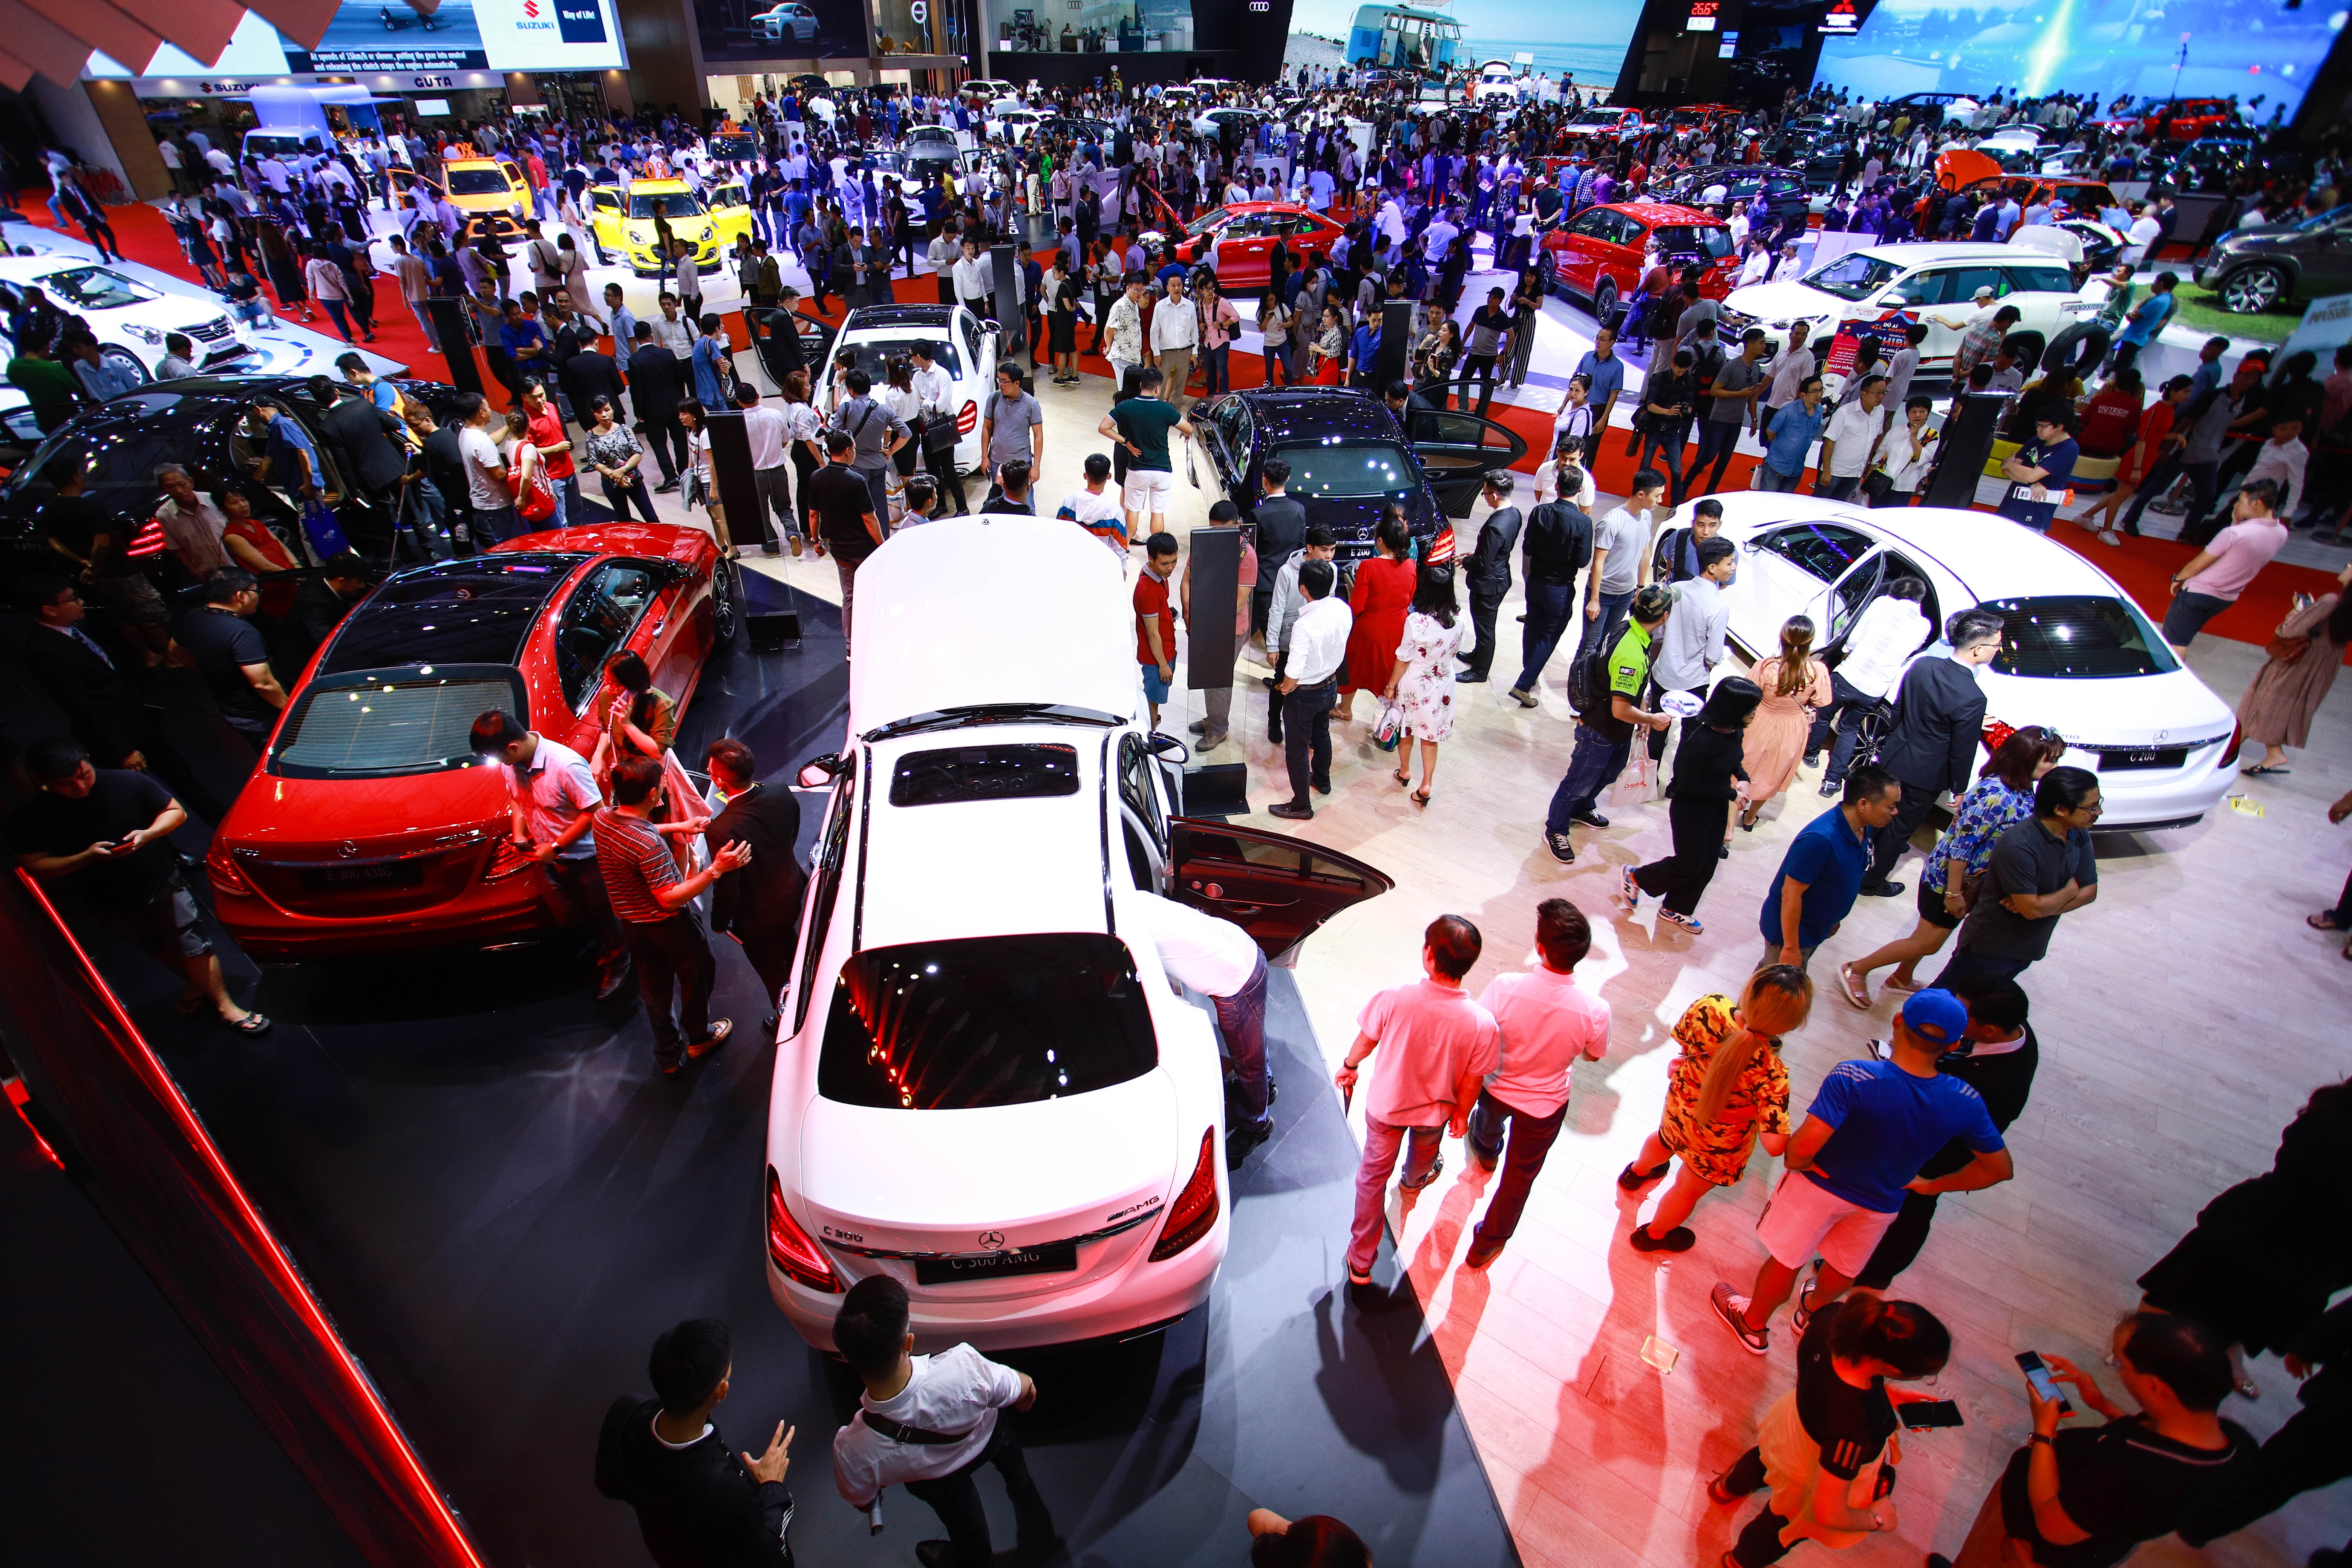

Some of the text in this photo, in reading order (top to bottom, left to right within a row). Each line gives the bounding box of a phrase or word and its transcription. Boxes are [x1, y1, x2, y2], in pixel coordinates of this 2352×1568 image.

[562, 10, 596, 20] Way of Life!
[310, 52, 318, 61] At
[318, 52, 339, 62] speeds
[338, 52, 346, 60] of
[346, 52, 368, 61] 15km/h
[375, 52, 396, 61] slower,
[395, 51, 415, 61] putting
[415, 51, 425, 60] the
[424, 52, 437, 61] gear
[436, 51, 448, 59] into
[447, 51, 467, 59] neutral
[313, 62, 326, 71] and
[325, 62, 353, 72] releasing
[351, 62, 362, 70] the
[362, 62, 380, 70] clutch
[380, 61, 395, 71] stops
[405, 61, 424, 71] engine
[423, 60, 459, 70] automatically.
[415, 77, 453, 88] GUTA
[723, 119, 740, 132] 0%
[455, 142, 476, 158] 0%
[644, 160, 670, 178] 0%
[2064, 303, 2106, 311] BRIDGESTONE
[2098, 405, 2128, 416] HUTECH
[2130, 752, 2156, 762] C 200
[327, 867, 392, 881] E 300 AMG
[824, 1225, 863, 1242] C 300
[1003, 1253, 1040, 1264] AMG
